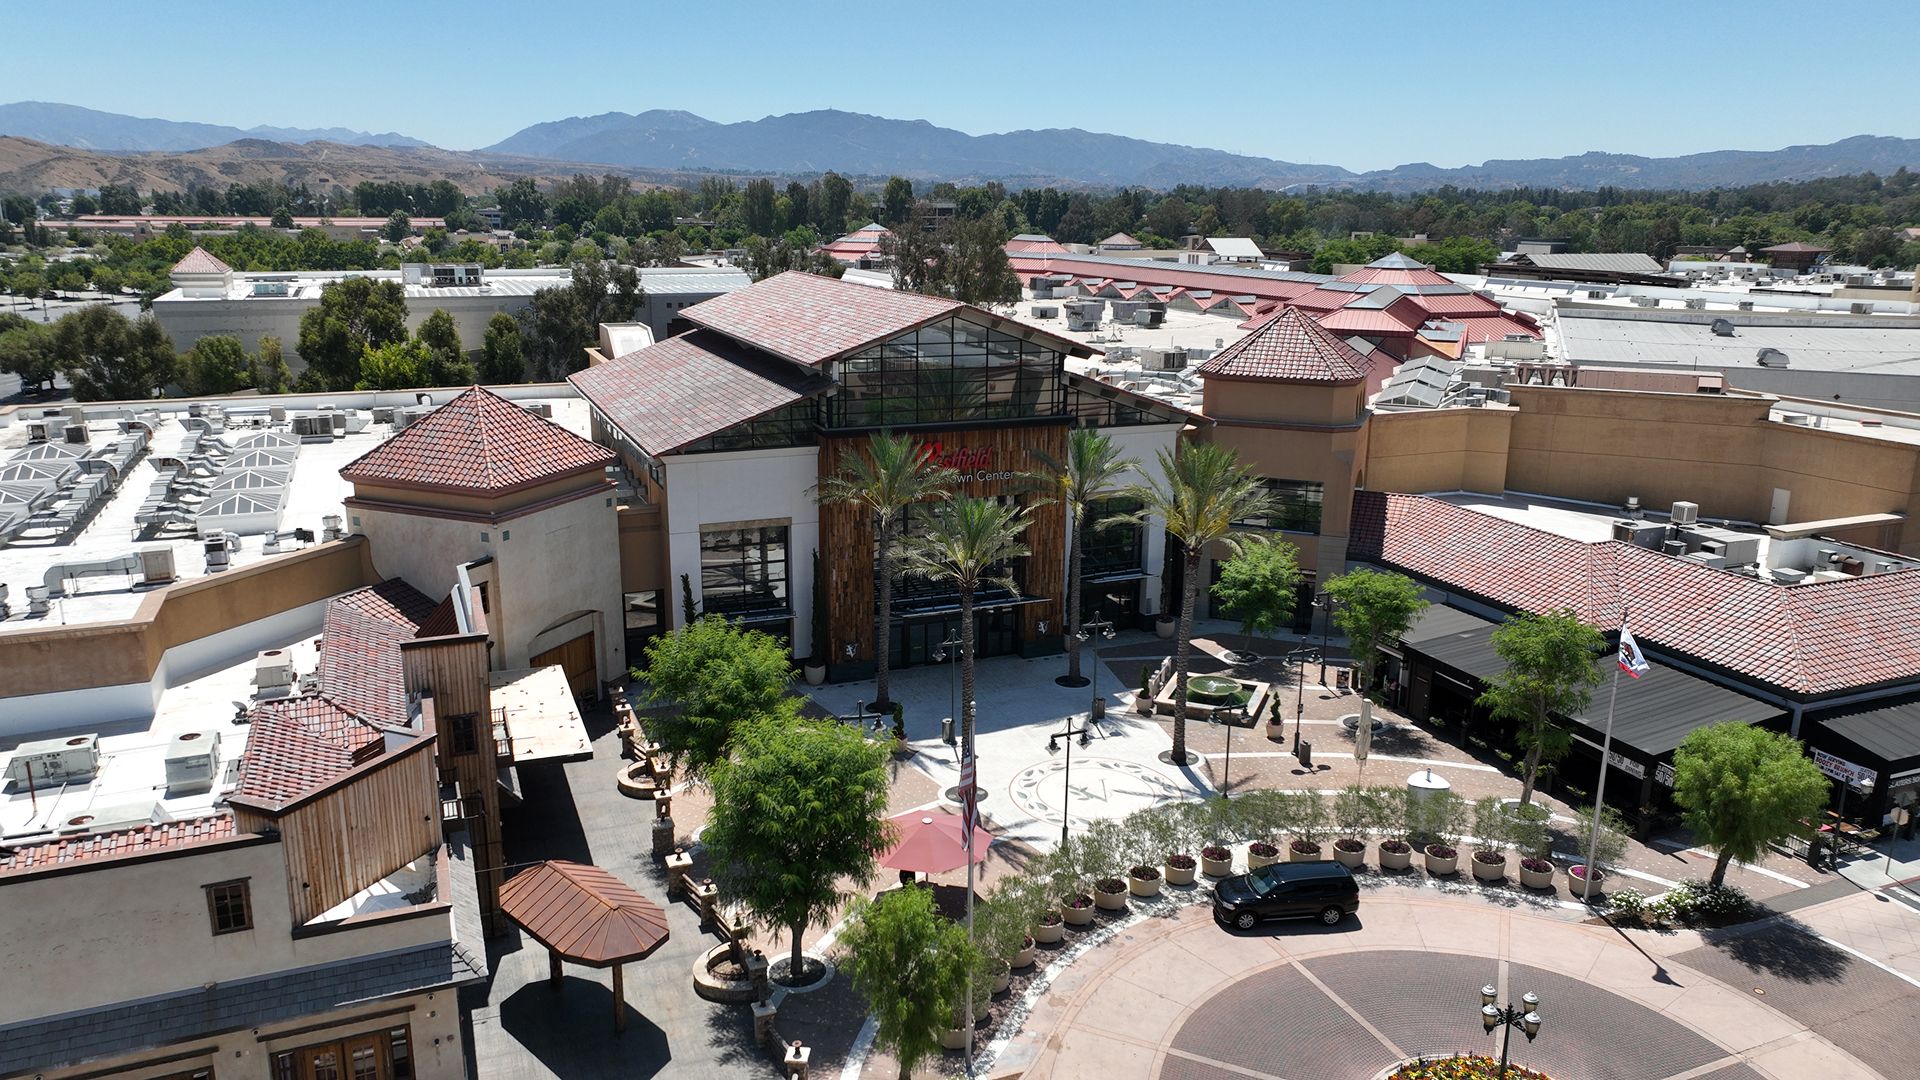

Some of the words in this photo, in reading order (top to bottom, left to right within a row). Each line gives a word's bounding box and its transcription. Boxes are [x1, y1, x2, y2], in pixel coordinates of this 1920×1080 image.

[914, 440, 993, 474] Westfield
[976, 469, 1014, 481] Center
[1834, 764, 1855, 776] BRUNCH
[1655, 770, 1674, 787] 50/50
